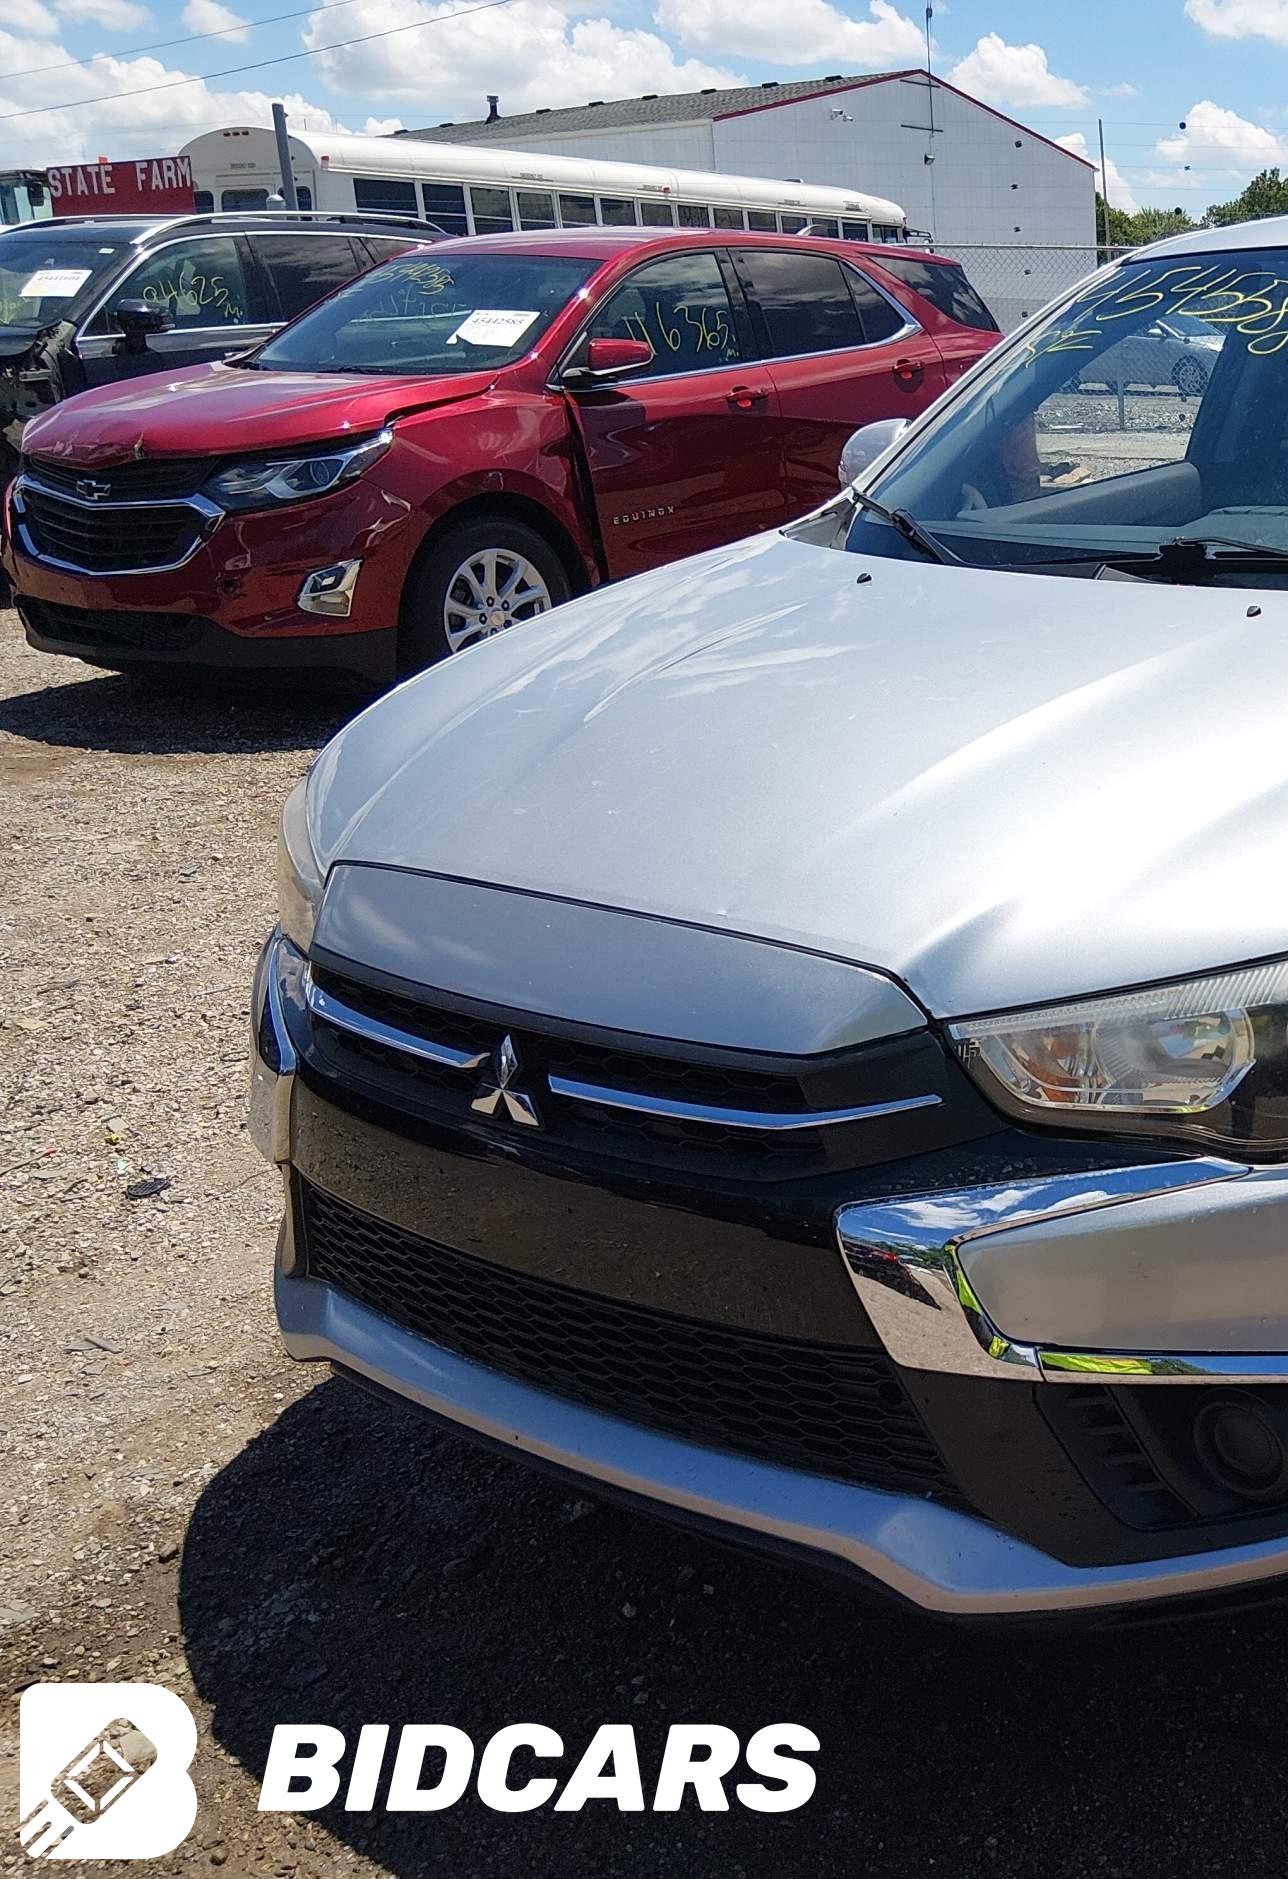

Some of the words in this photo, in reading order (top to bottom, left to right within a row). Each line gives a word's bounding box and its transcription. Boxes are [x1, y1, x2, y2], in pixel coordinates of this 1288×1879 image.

[48, 164, 116, 199] STATE
[136, 157, 192, 192] FARM
[612, 505, 675, 526] EQUINOX
